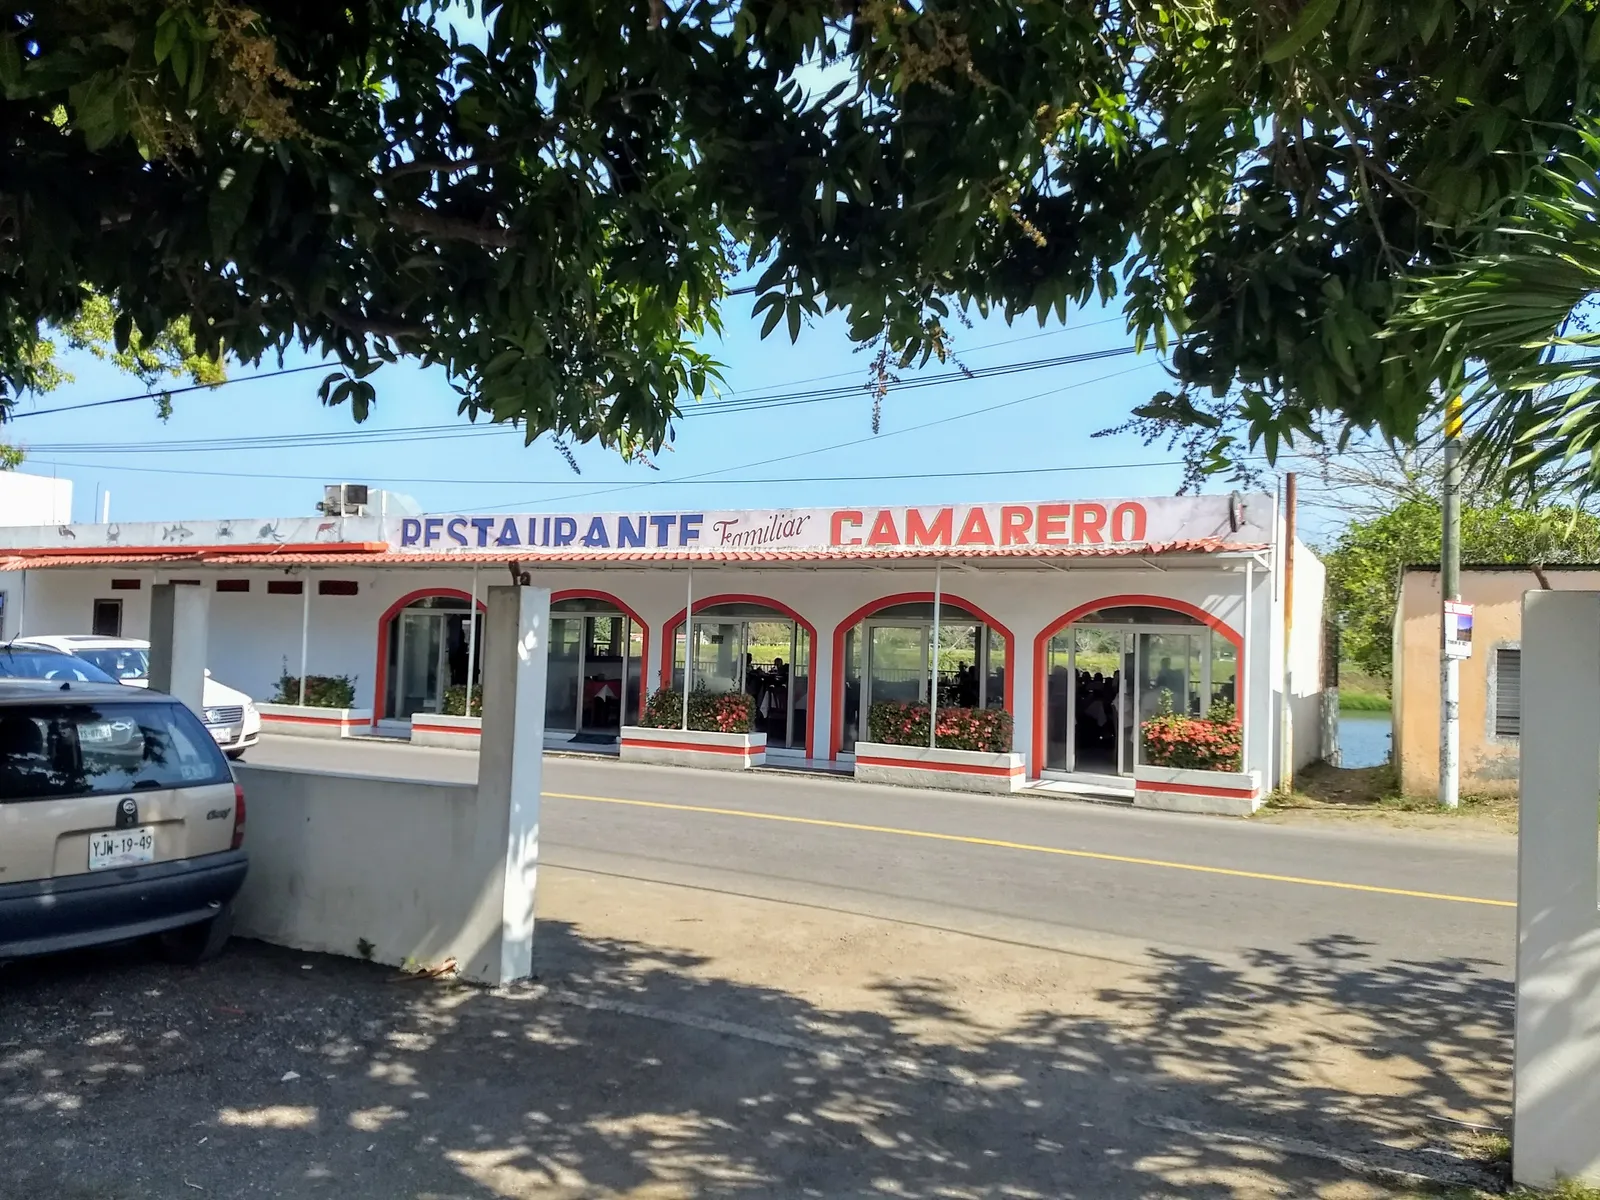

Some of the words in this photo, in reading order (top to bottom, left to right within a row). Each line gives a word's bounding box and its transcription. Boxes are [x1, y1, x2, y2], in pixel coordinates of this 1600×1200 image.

[401, 514, 703, 548] RESTAURANTE
[712, 513, 811, 546] Familiar
[830, 501, 1147, 546] CAMARERO
